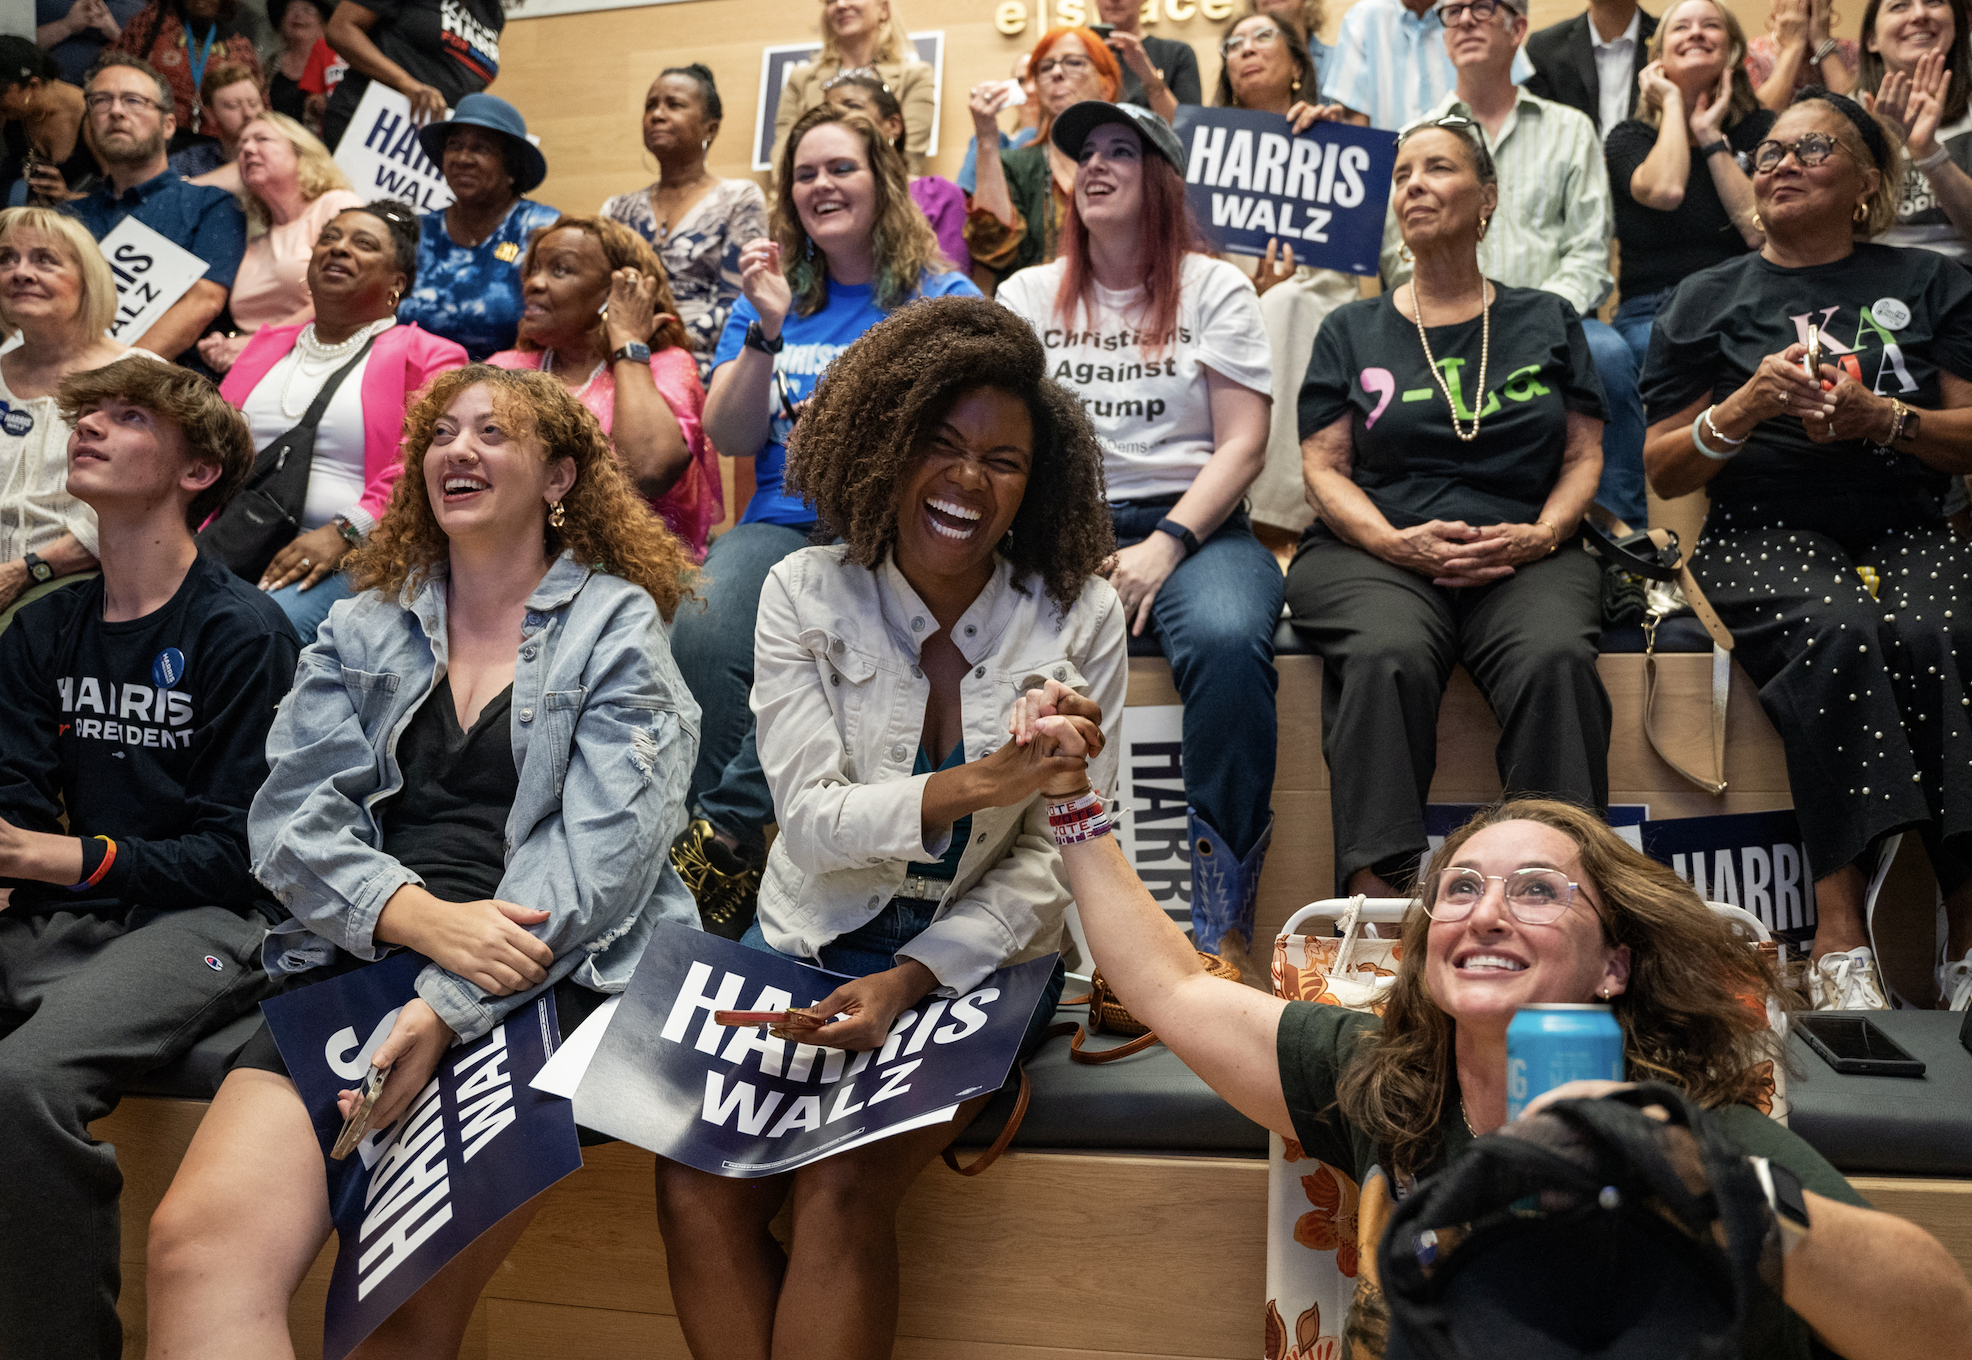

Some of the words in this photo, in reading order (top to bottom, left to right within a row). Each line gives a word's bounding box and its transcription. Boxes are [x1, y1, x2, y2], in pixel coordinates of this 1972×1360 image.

[375, 164, 458, 212] WAL
[1186, 125, 1370, 209] HARRIS
[1212, 193, 1333, 244] WALZ
[110, 282, 161, 337] ALZ
[772, 342, 850, 375] HRIS
[1055, 357, 1177, 385] Against
[1082, 398, 1166, 423] rump
[56, 676, 194, 726] HARIS
[1046, 801, 1077, 817] OTE
[1131, 741, 1195, 938] HARRI
[1672, 841, 1816, 933] HARRI
[452, 1023, 517, 1164] WAL
[702, 1069, 923, 1139] WALZ
